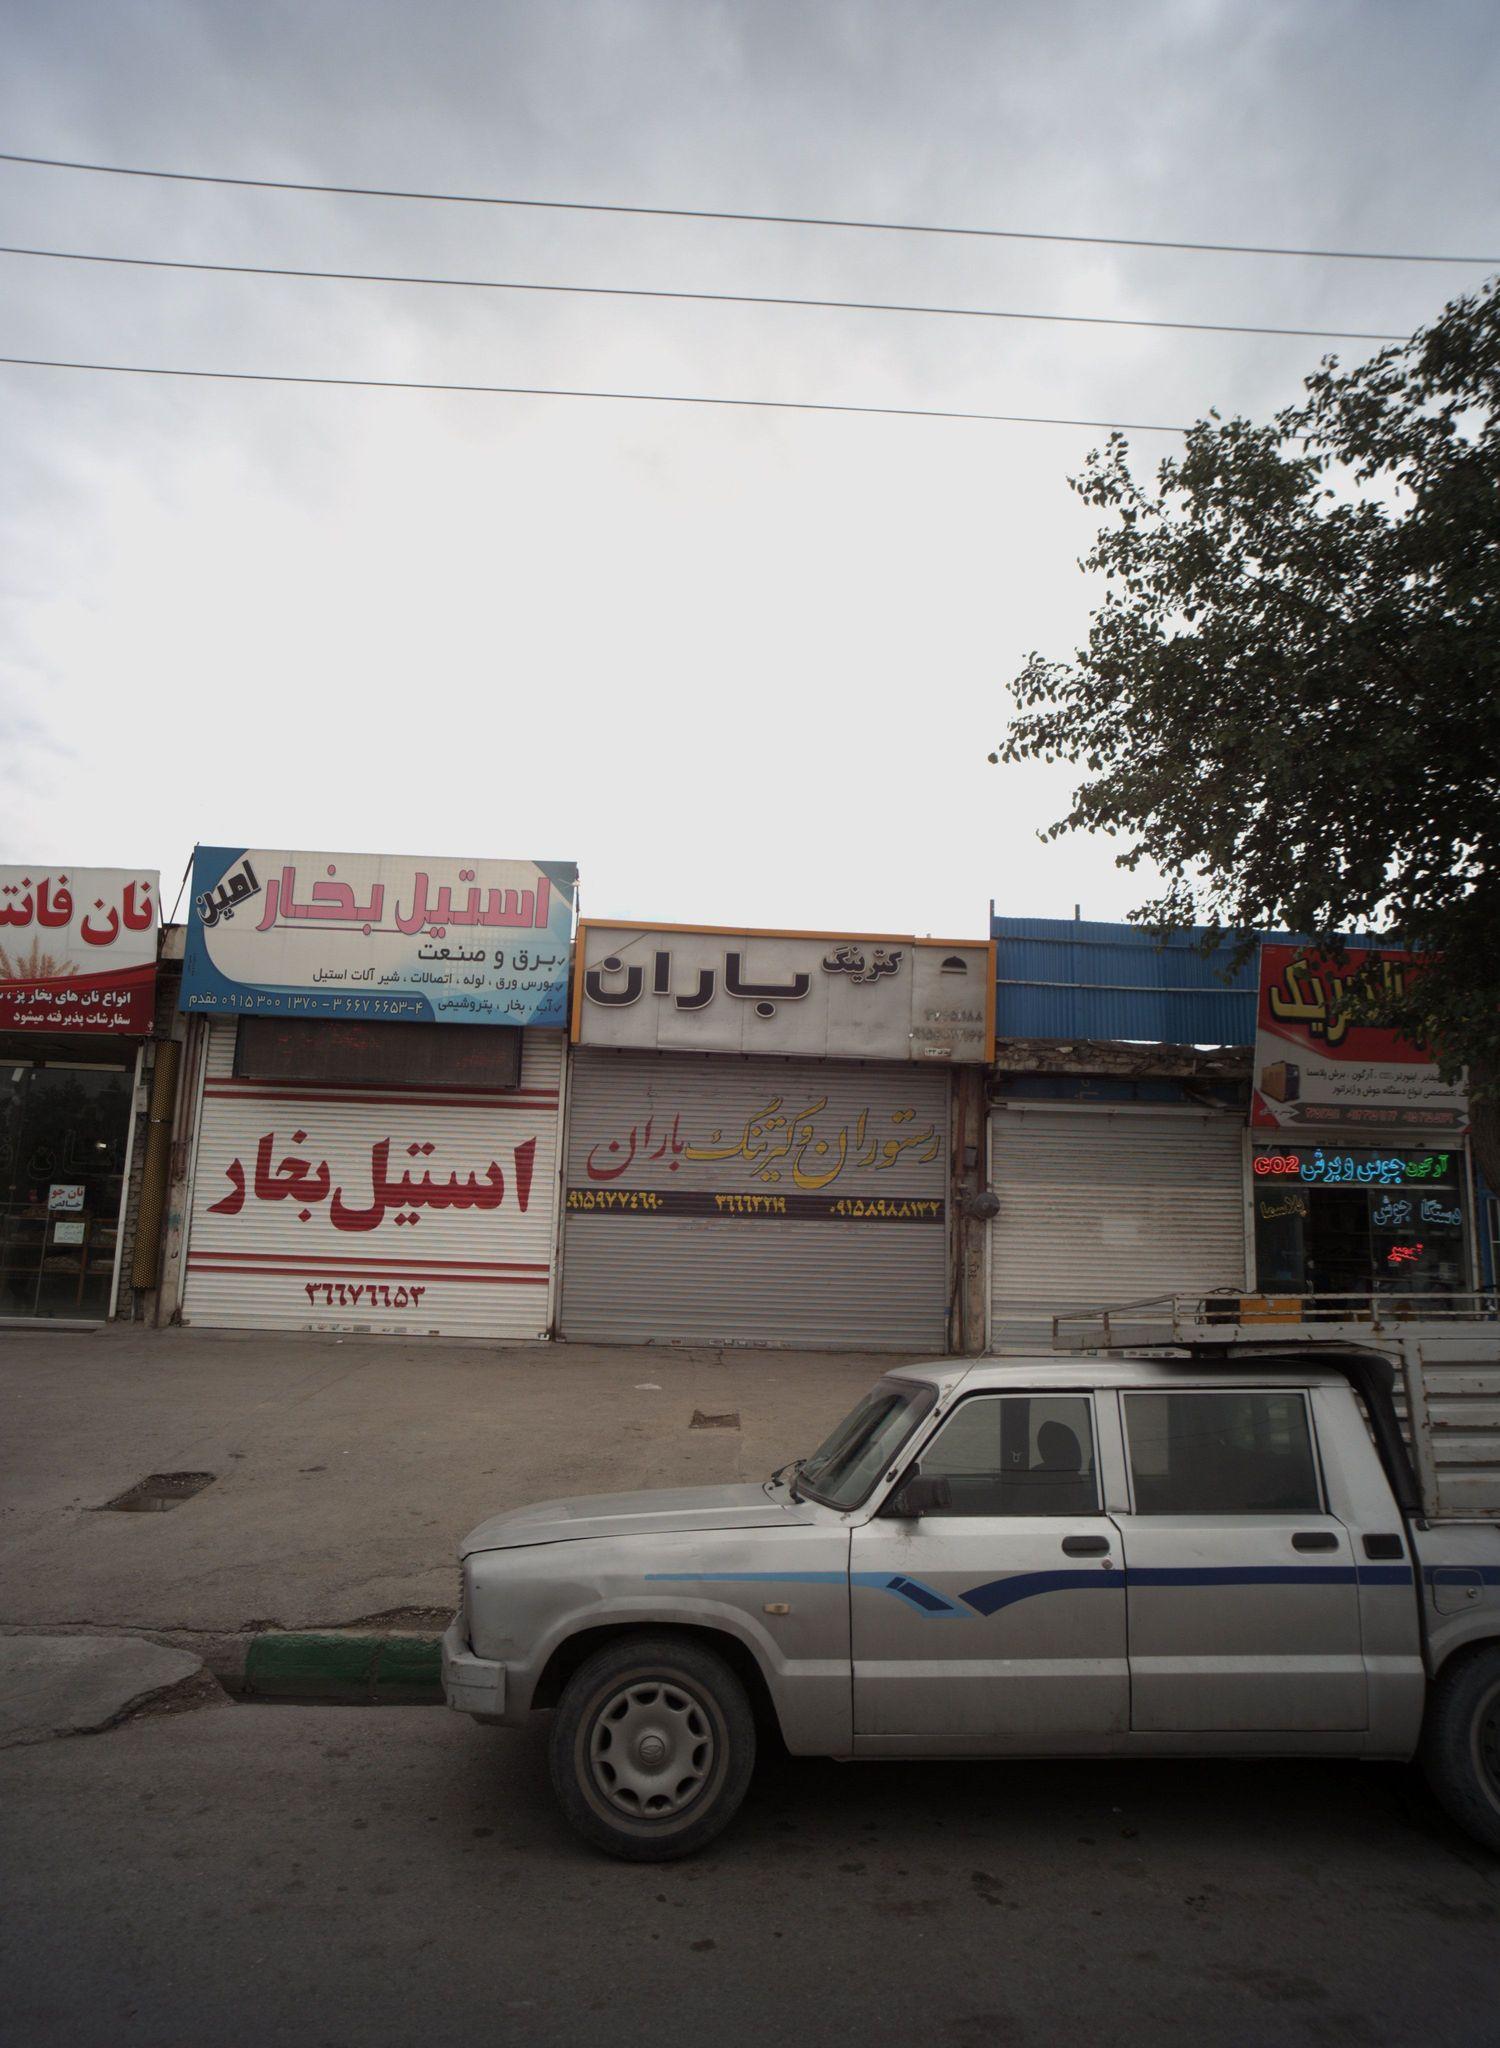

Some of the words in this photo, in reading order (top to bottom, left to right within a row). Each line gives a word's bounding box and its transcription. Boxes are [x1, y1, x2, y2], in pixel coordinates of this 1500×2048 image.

[0, 874, 73, 927] فانت
[196, 859, 261, 927] امین
[255, 864, 385, 935] بخار
[395, 869, 551, 939] استیل
[81, 880, 153, 946] نان
[418, 944, 486, 962] صنعت
[494, 950, 504, 969] و
[513, 950, 556, 972] برق
[822, 946, 903, 983] کترینگ
[313, 968, 347, 982] استیل
[351, 968, 375, 980] آلات
[378, 970, 400, 985] شیر
[411, 973, 452, 984] اتصالات
[464, 974, 485, 988] لوله
[585, 950, 812, 1018] باران
[28, 988, 52, 1004] بخار
[55, 989, 79, 1005] های
[81, 990, 99, 1006] نان
[102, 991, 131, 1007] انواع
[189, 992, 217, 1007] مقدم
[438, 998, 493, 1014] پتروشیمی
[504, 1000, 525, 1013] بخار
[13, 1010, 44, 1024] میشود
[47, 1010, 83, 1026] پذیرفته
[86, 1012, 131, 1028] سفارشات
[586, 1112, 685, 1180] باران
[792, 1107, 941, 1190] رستوران
[1254, 1155, 1300, 1175] CO2
[206, 1129, 331, 1222] بخار
[330, 1136, 537, 1232] استیل
[68, 1187, 83, 1199] نان
